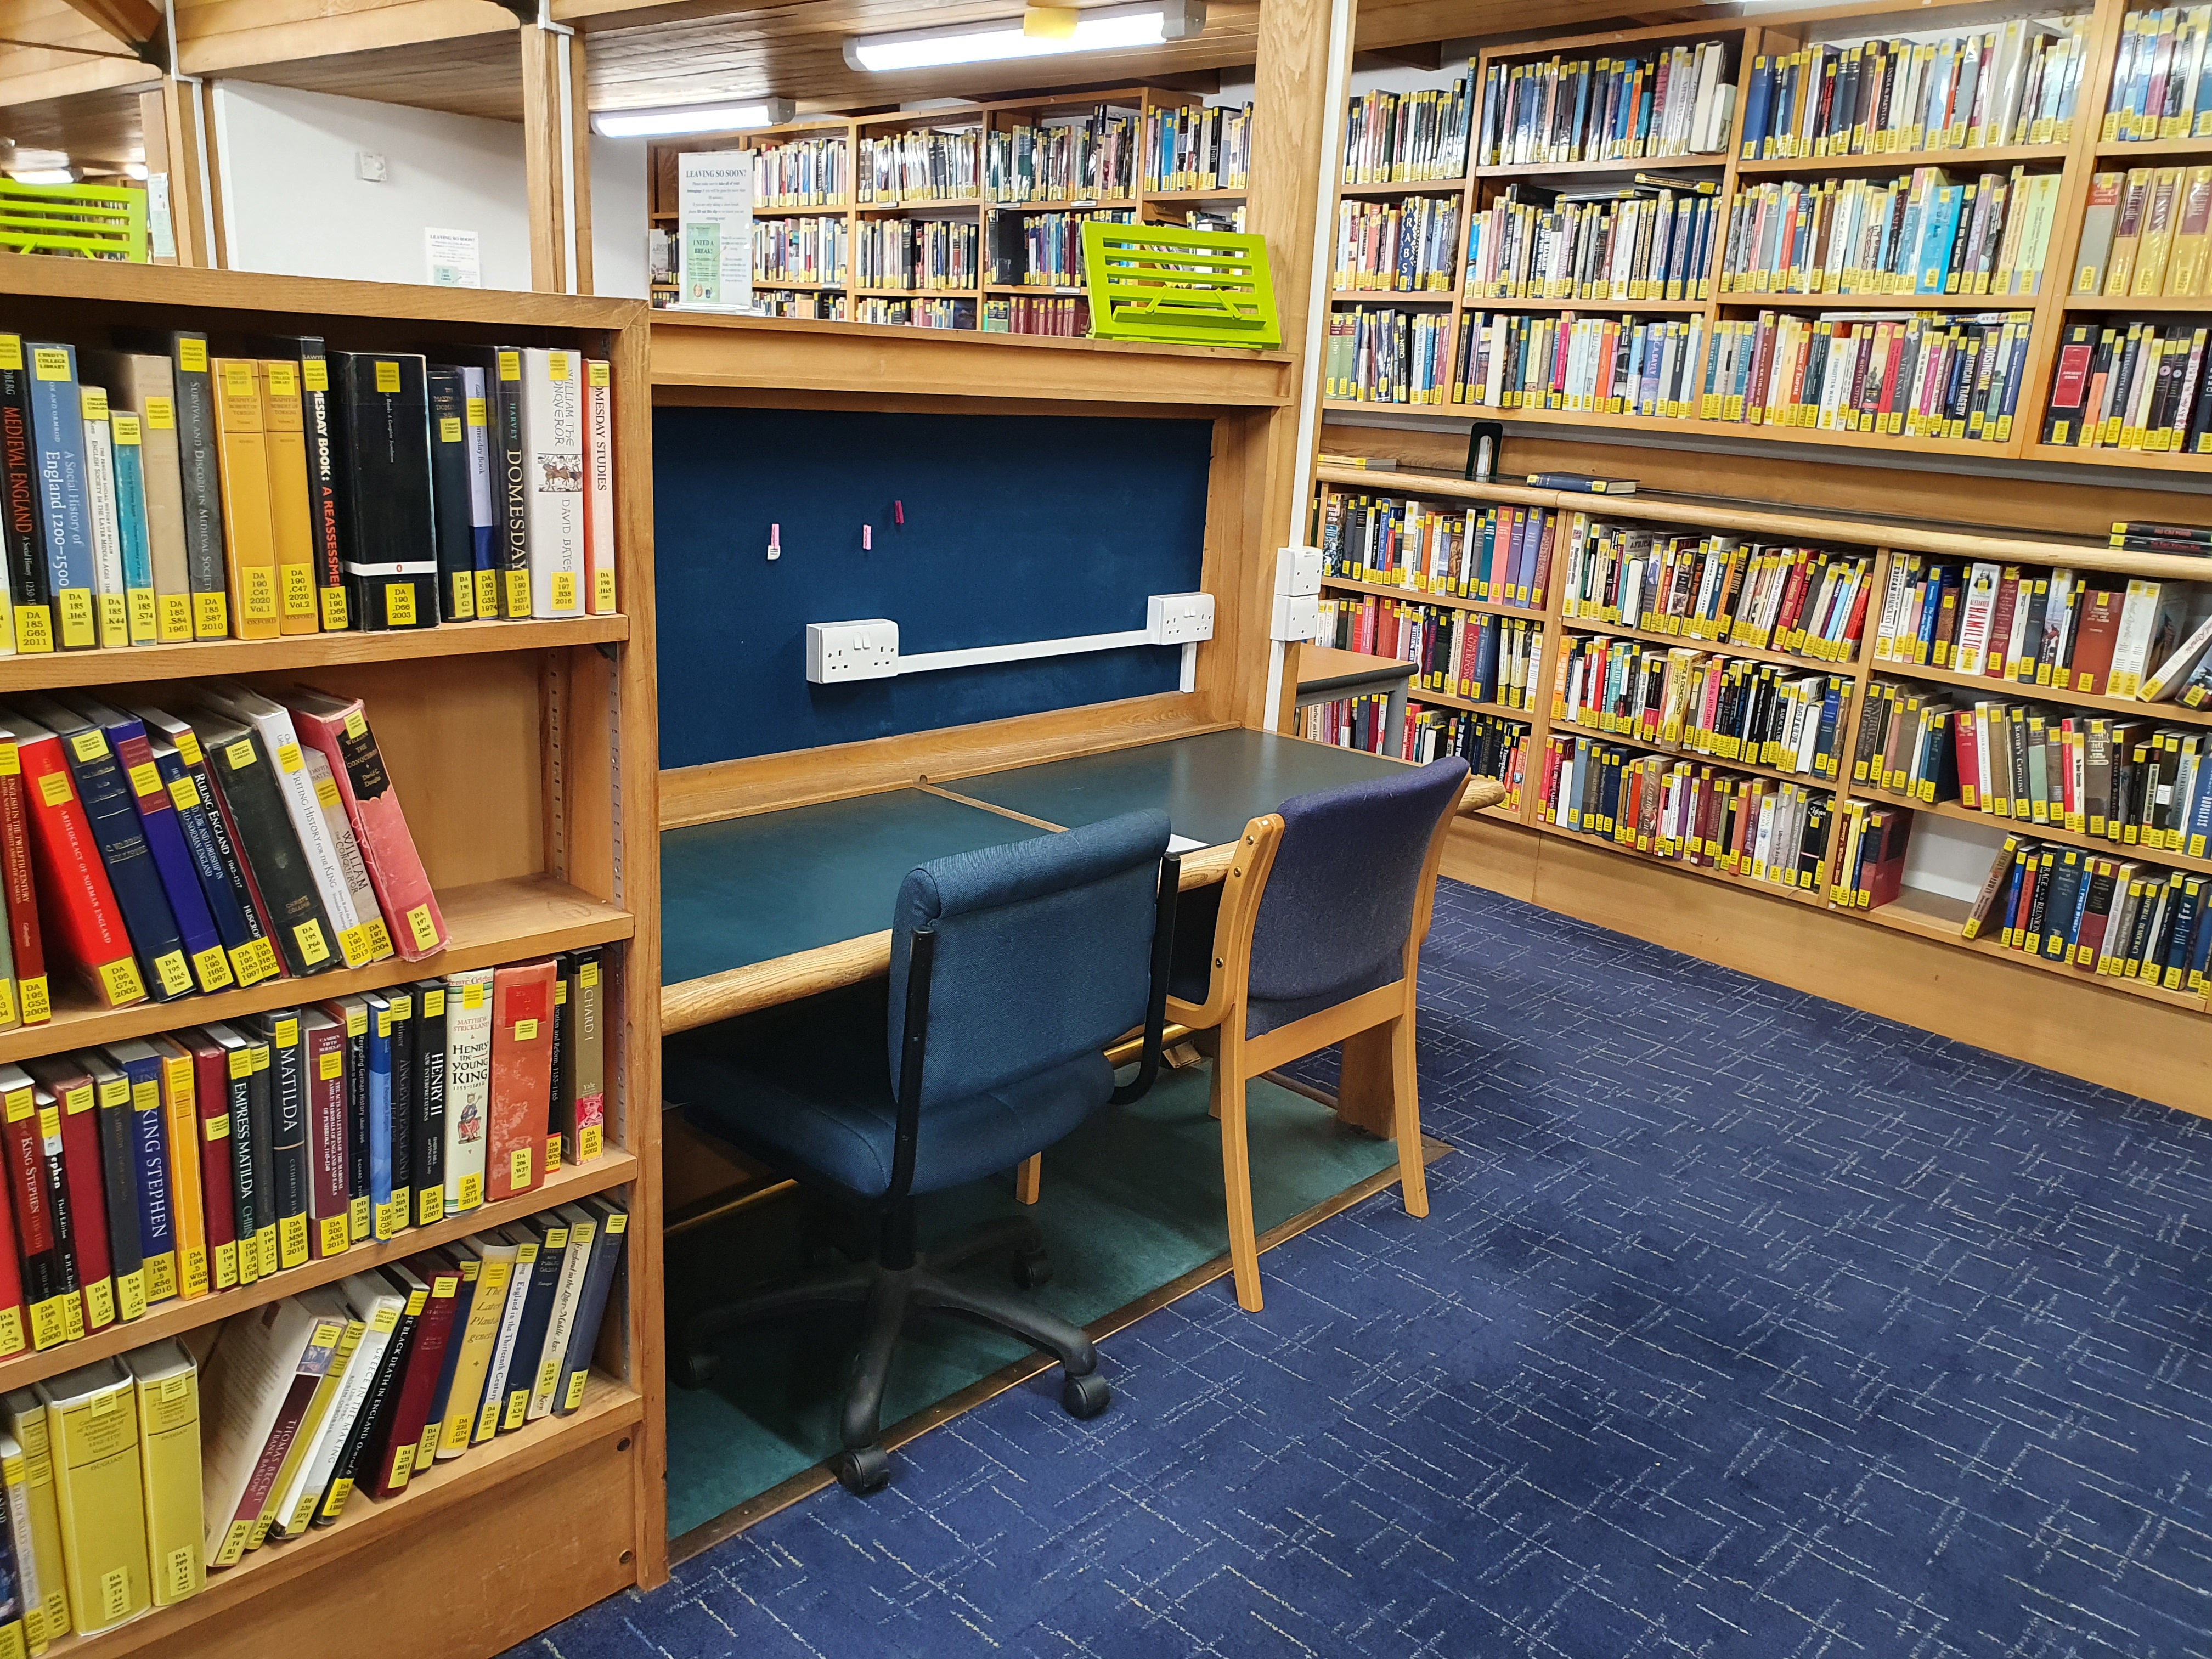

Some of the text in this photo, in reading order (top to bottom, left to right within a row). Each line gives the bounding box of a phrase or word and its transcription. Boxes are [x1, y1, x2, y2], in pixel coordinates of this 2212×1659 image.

[1886, 67, 1894, 88] INDIA
[1880, 95, 1889, 126] PAKISTAN
[1650, 354, 1659, 375] BAYLY
[1830, 358, 1839, 390] FORGOTTEN
[1857, 359, 1865, 386] MOBILE
[1895, 357, 1907, 398] VIETNAM
[1955, 386, 1970, 416] TRAGEDY
[3, 407, 27, 467] MEDIEVAL
[509, 403, 518, 441] HARVEY
[65, 461, 79, 492] Social
[318, 438, 331, 481] BOOK:
[596, 441, 607, 490] STUDIES
[94, 469, 103, 494] SOCIETY
[190, 381, 212, 591] SURVIVAL AND DISCORD IN MEDIEVAL SOCIETY
[323, 486, 332, 496] A
[10, 473, 33, 533] ENGLAND
[44, 451, 70, 587] England 1200-1500
[69, 494, 81, 532] History
[506, 449, 527, 570] DOMESDAY
[73, 534, 85, 547] of
[323, 500, 341, 588] REASSESSME
[562, 499, 572, 571] DAVID BATES
[1961, 607, 1988, 657] HAMILTO
[1675, 681, 1686, 715] DEMOCRACY
[2014, 725, 2024, 793] SLAVERY'S CAPITALISM
[292, 770, 309, 806] WRITING
[195, 772, 214, 810] RULING
[208, 810, 230, 855] ENGLAND
[228, 859, 242, 889] 1042-1217
[304, 805, 323, 843] HISTORY
[15, 834, 26, 868] TWELFTH
[320, 855, 329, 868] THE
[335, 841, 360, 894] CONQUEROR
[342, 830, 368, 890] WILLIAM
[18, 868, 30, 902] CENTURY
[60, 809, 112, 944] ARISTOCRACY OF NORMAN ENGLAND
[324, 865, 337, 888] KING
[2041, 867, 2051, 886] RACE
[2033, 901, 2045, 933] REUNION
[2132, 923, 2145, 955] DEMOCRACY
[111, 966, 125, 975] DA
[112, 973, 130, 983] 195
[114, 979, 134, 991] .G74
[114, 986, 138, 998] 2002
[457, 1015, 488, 1025] MATTHEW
[452, 1057, 488, 1072] YOUNG
[453, 1041, 489, 1055] HENRY
[431, 1052, 444, 1116] HENRY II
[453, 1069, 488, 1085] KING
[280, 1047, 298, 1197] MATILDA CATHERINE
[21, 1136, 34, 1166] KING
[234, 1082, 254, 1199] EMPRESS MATILDA
[25, 1166, 40, 1214] STEPHEN
[143, 1109, 168, 1239] KING STEPHEN
[476, 1302, 502, 1312] Later
[484, 1286, 503, 1296] The
[511, 1282, 525, 1311] England
[506, 1319, 515, 1332] the
[362, 1347, 383, 1383] GREECE
[496, 1333, 514, 1373] Thirteenth
[343, 1375, 356, 1398] ROBIN
[356, 1386, 367, 1398] IN
[361, 1326, 410, 1440] BLACK DEATH IN ENGLAND
[489, 1373, 504, 1401] Century
[326, 1400, 345, 1434] OSBORNE
[347, 1401, 361, 1419] THE
[328, 1421, 350, 1464] MAKING
[250, 1429, 283, 1492] FRANK BARLOW
[253, 1419, 297, 1503] THOMAS BECKET
